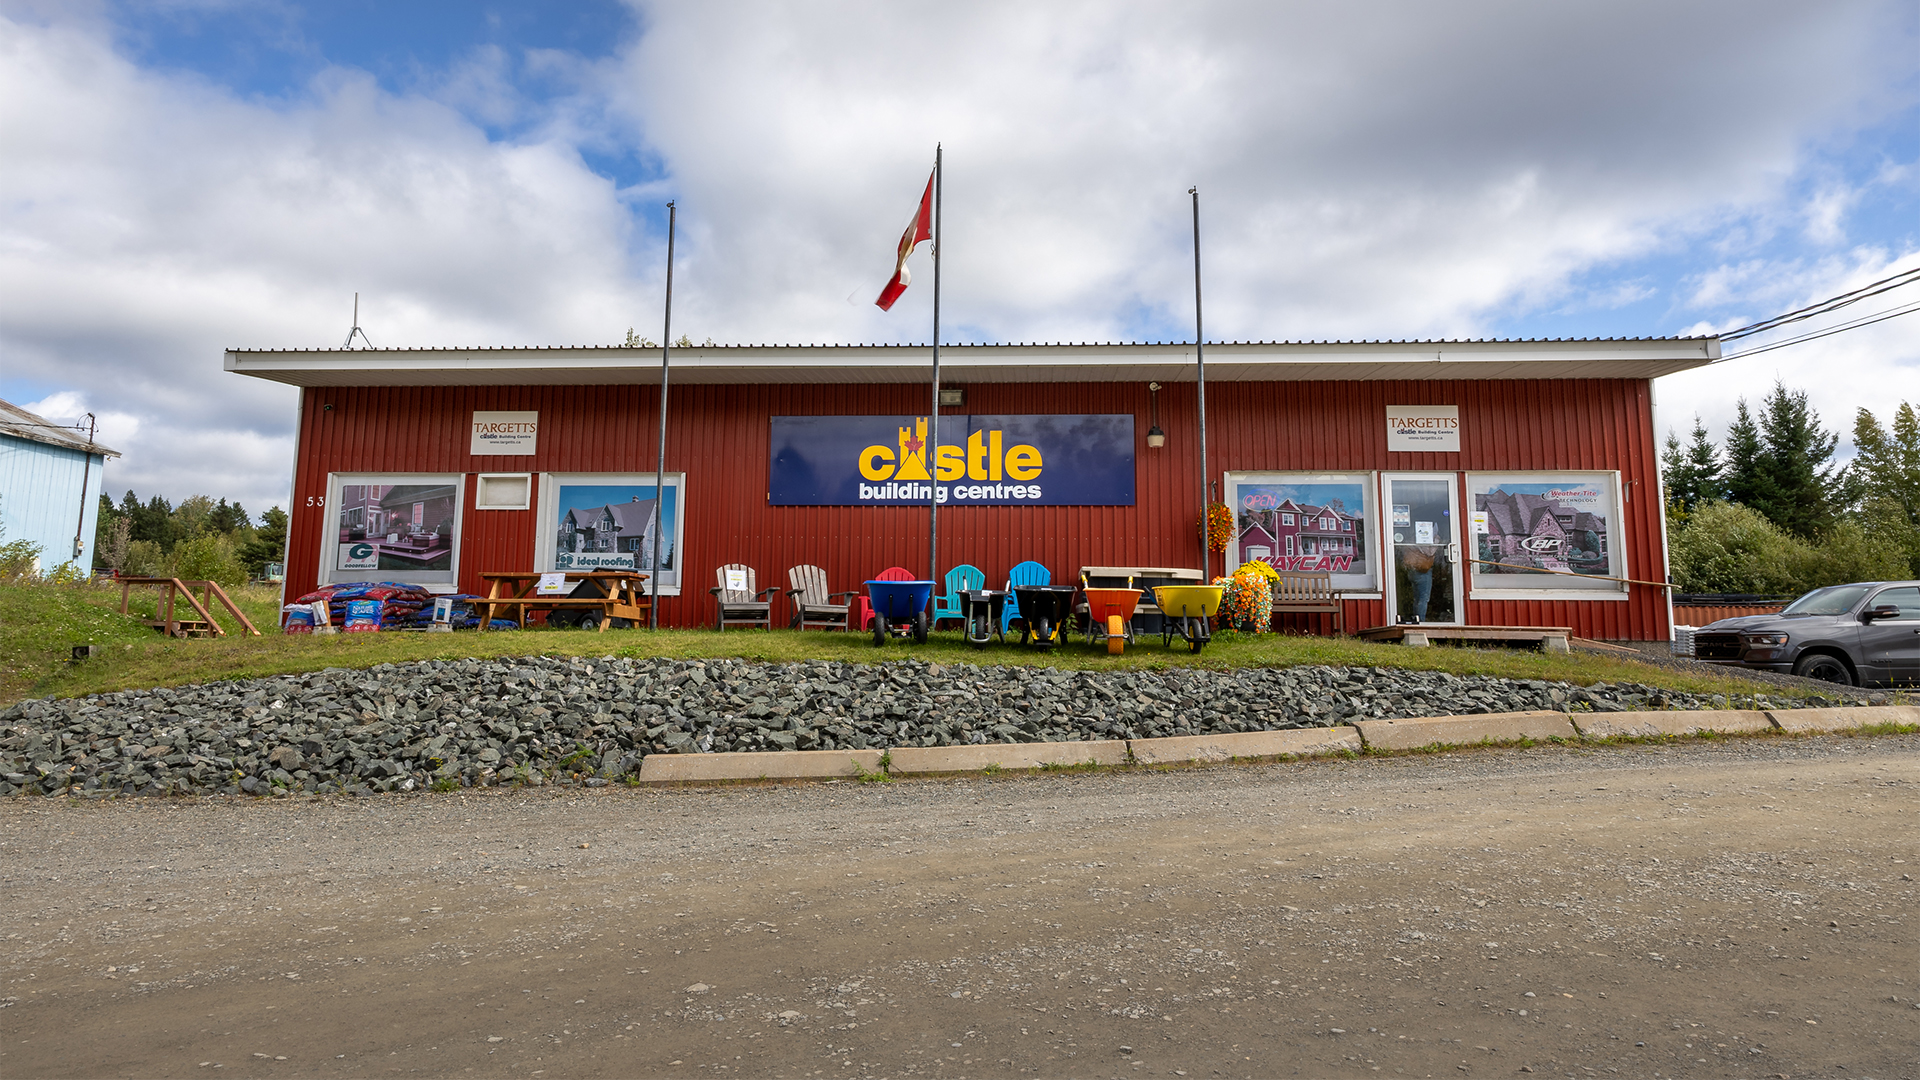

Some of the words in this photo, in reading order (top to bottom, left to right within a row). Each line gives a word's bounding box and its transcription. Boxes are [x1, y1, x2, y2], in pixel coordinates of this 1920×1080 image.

[473, 422, 536, 433] TARGETTS
[1388, 417, 1458, 428] TARGETTS
[858, 417, 1043, 482] castle
[859, 482, 948, 503] building
[953, 482, 1042, 500] centres
[1244, 494, 1276, 507] OPEN
[1530, 539, 1562, 549] BP
[577, 556, 600, 566] ideal
[601, 556, 633, 568] roofing
